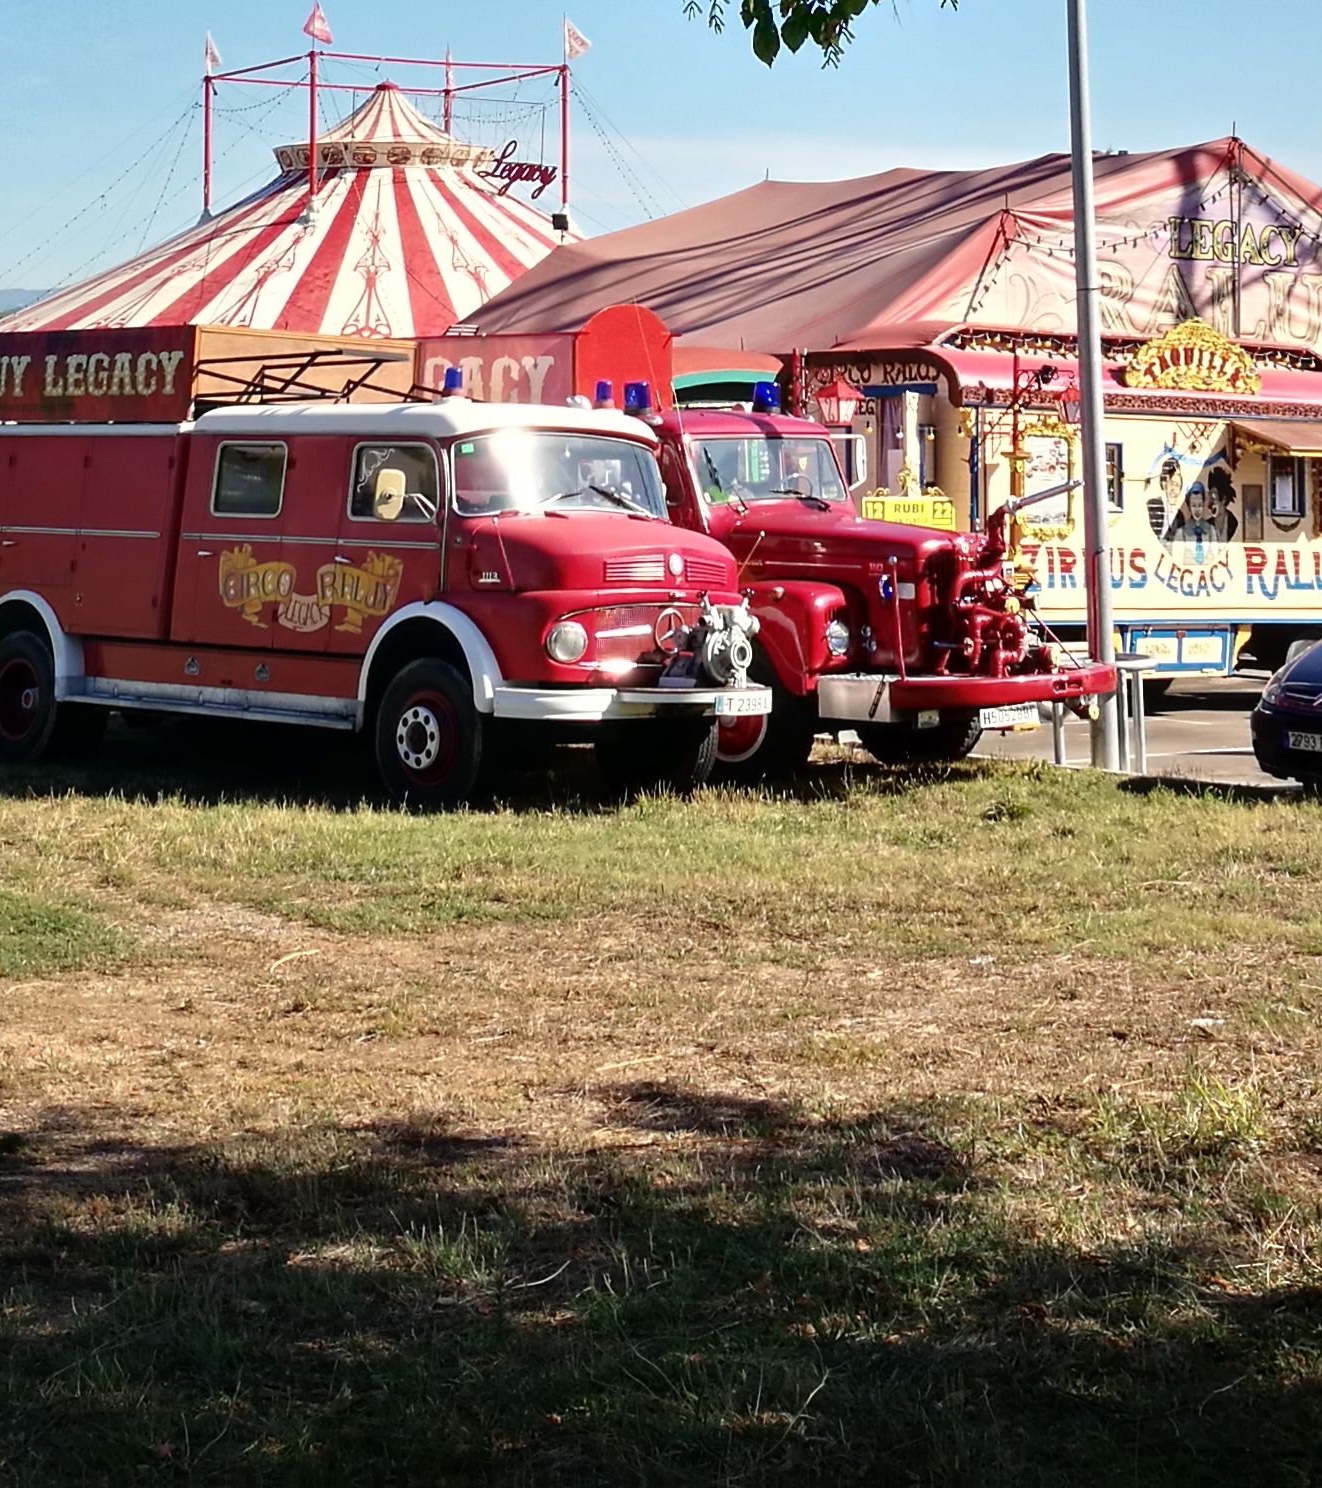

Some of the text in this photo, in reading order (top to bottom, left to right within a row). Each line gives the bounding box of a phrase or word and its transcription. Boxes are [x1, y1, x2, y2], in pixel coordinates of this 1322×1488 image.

[478, 140, 557, 199] Legacy
[1168, 216, 1305, 267] LEGACY
[43, 350, 184, 397] LEGACY
[933, 502, 952, 520] 22
[222, 567, 295, 599] CIRCO
[320, 569, 396, 611] RALUY
[1020, 545, 1148, 592] ZIRUS
[1154, 550, 1234, 597] LEGACY
